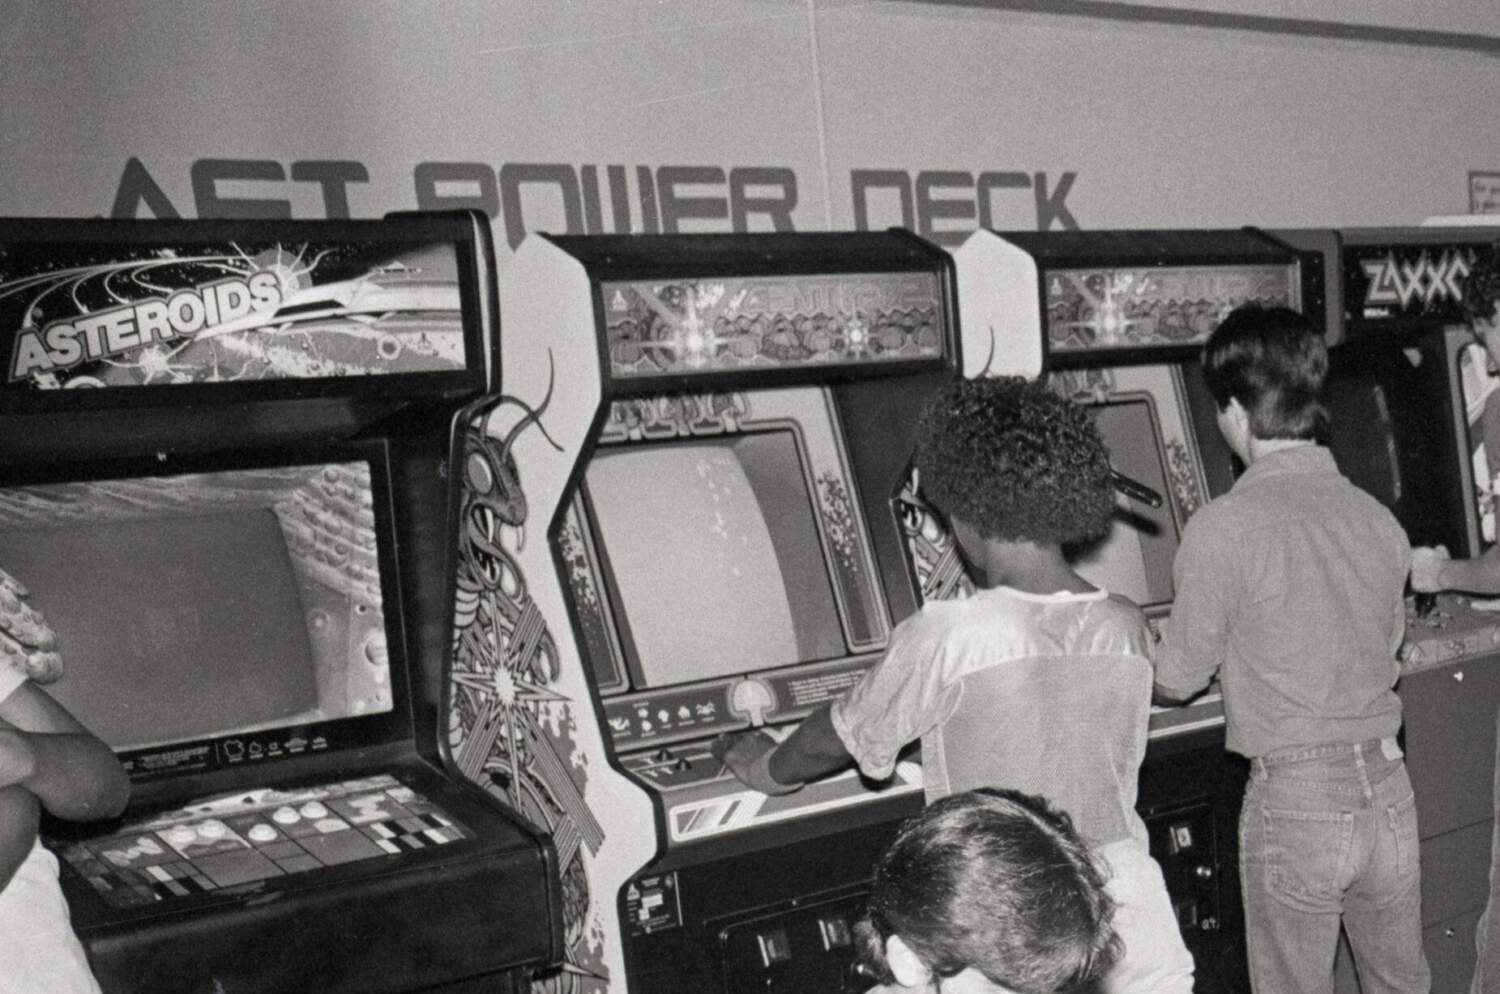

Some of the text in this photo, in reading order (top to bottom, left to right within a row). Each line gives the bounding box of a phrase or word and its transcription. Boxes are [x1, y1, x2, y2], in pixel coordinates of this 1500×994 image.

[414, 161, 798, 251] POWER
[851, 169, 1081, 247] DECK
[10, 270, 282, 380] ASTEROIDS
